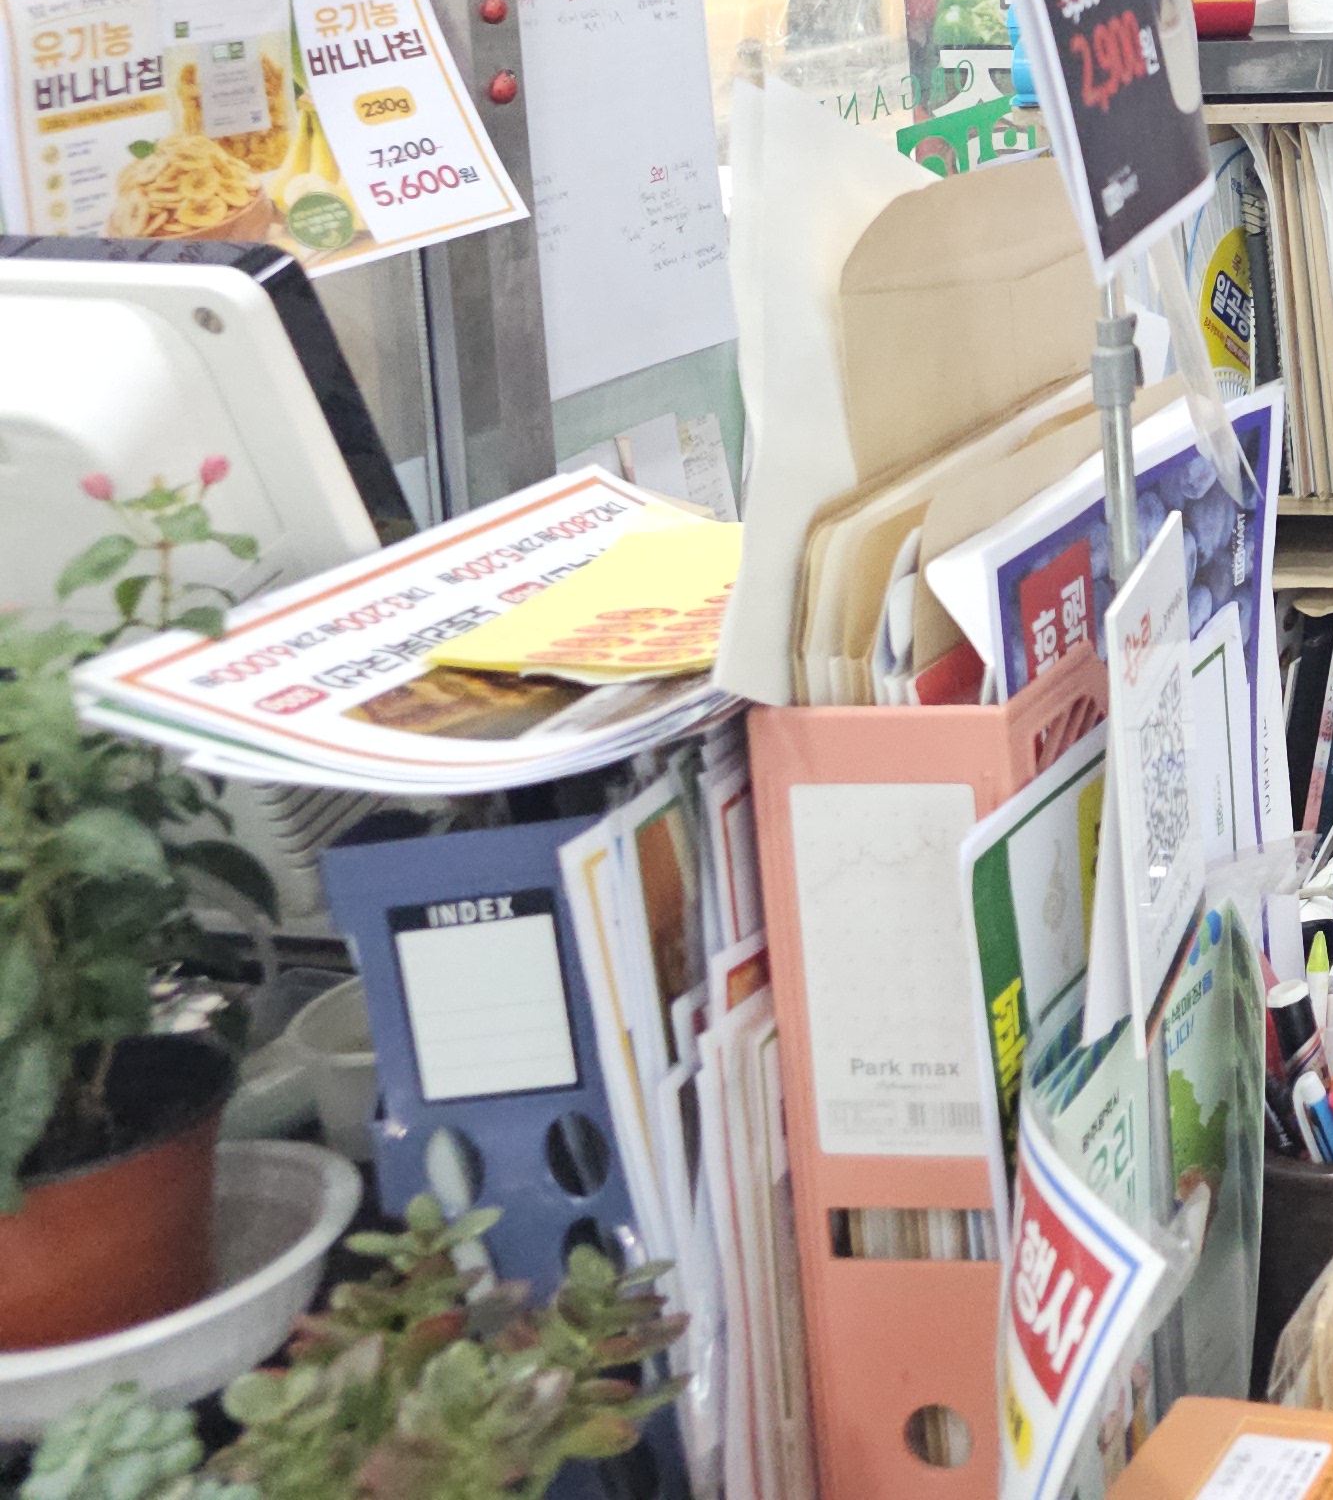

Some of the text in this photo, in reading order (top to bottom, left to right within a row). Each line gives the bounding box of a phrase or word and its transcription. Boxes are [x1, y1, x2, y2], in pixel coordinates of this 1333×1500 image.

[315, 0, 400, 38] 유기농
[32, 18, 132, 68] 유기농
[306, 28, 428, 77] 바나나칩
[33, 54, 165, 112] 바나나칩
[360, 97, 411, 119] 230g
[368, 164, 480, 208] 5,600원
[427, 896, 516, 928] INDEX
[850, 1057, 960, 1078] Park max
[1015, 1218, 1094, 1374] 행사
